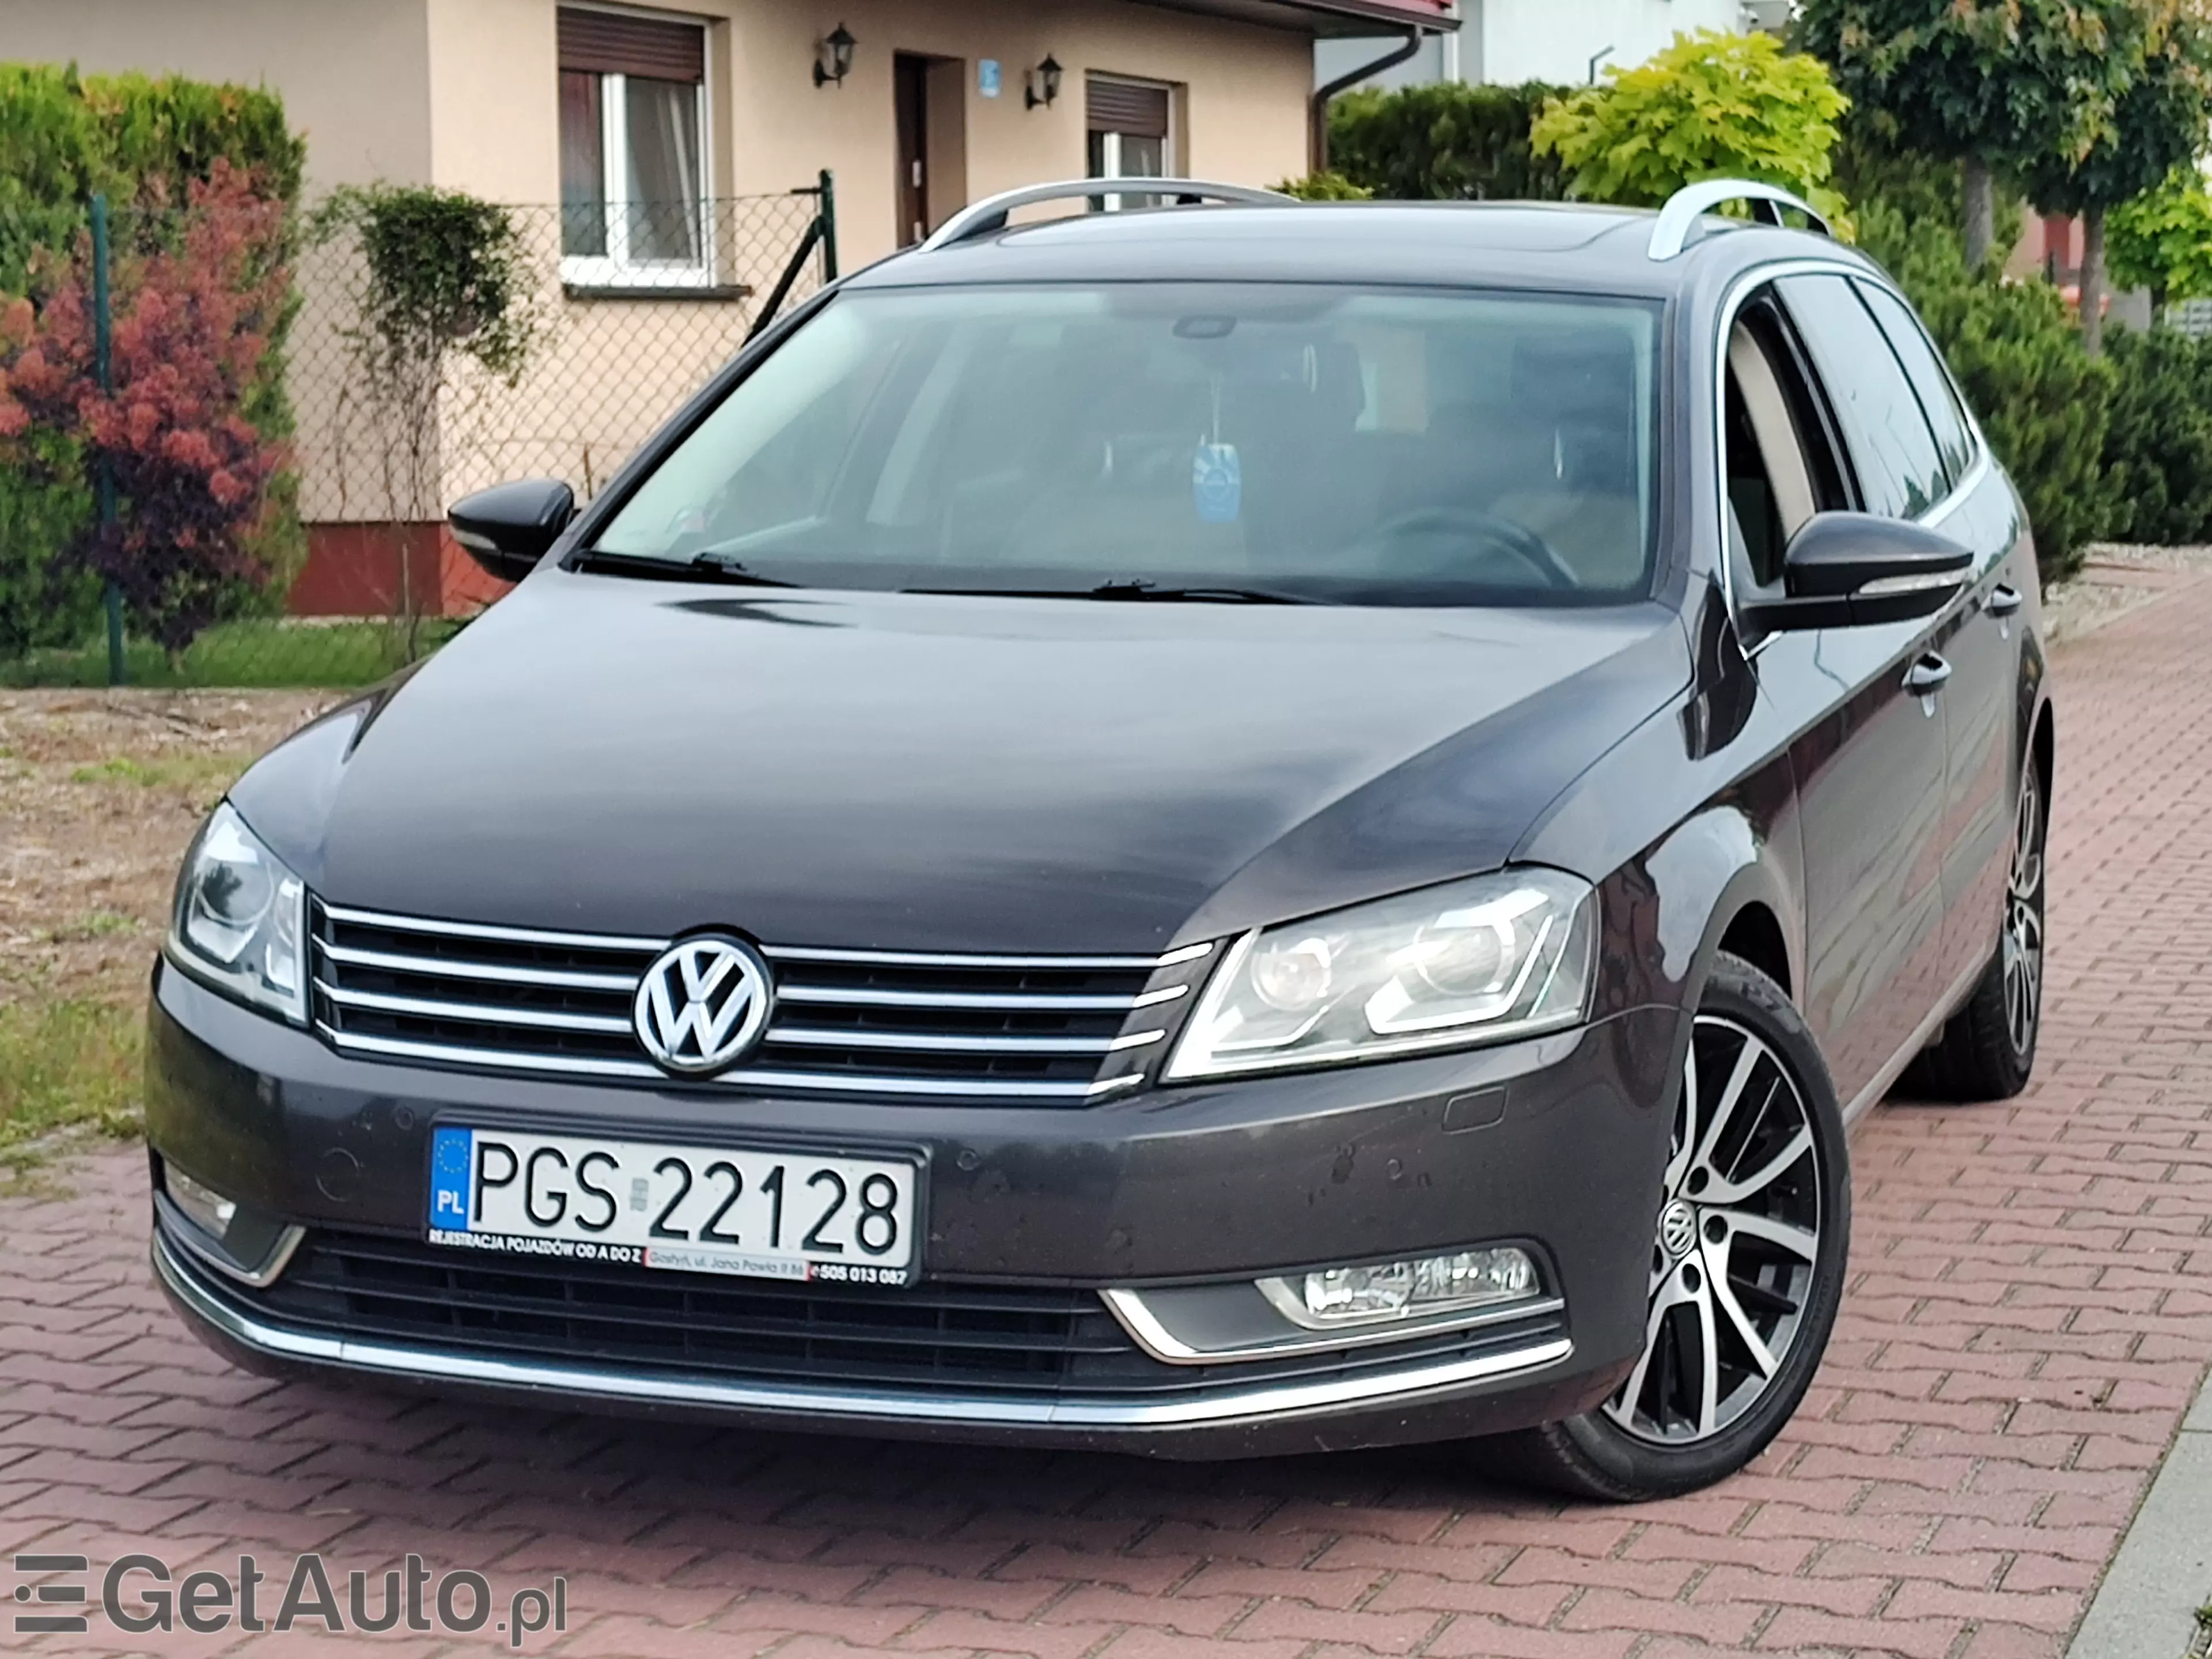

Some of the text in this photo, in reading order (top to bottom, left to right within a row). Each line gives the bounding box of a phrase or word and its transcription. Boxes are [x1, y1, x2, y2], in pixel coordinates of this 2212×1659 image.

[636, 940, 766, 1071] VW
[437, 1190, 465, 1214] PL
[474, 1142, 899, 1255] PGS 22128
[575, 1243, 596, 1258] OD
[597, 1245, 608, 1260] A
[609, 1246, 631, 1262] DO
[631, 1248, 642, 1263] Z
